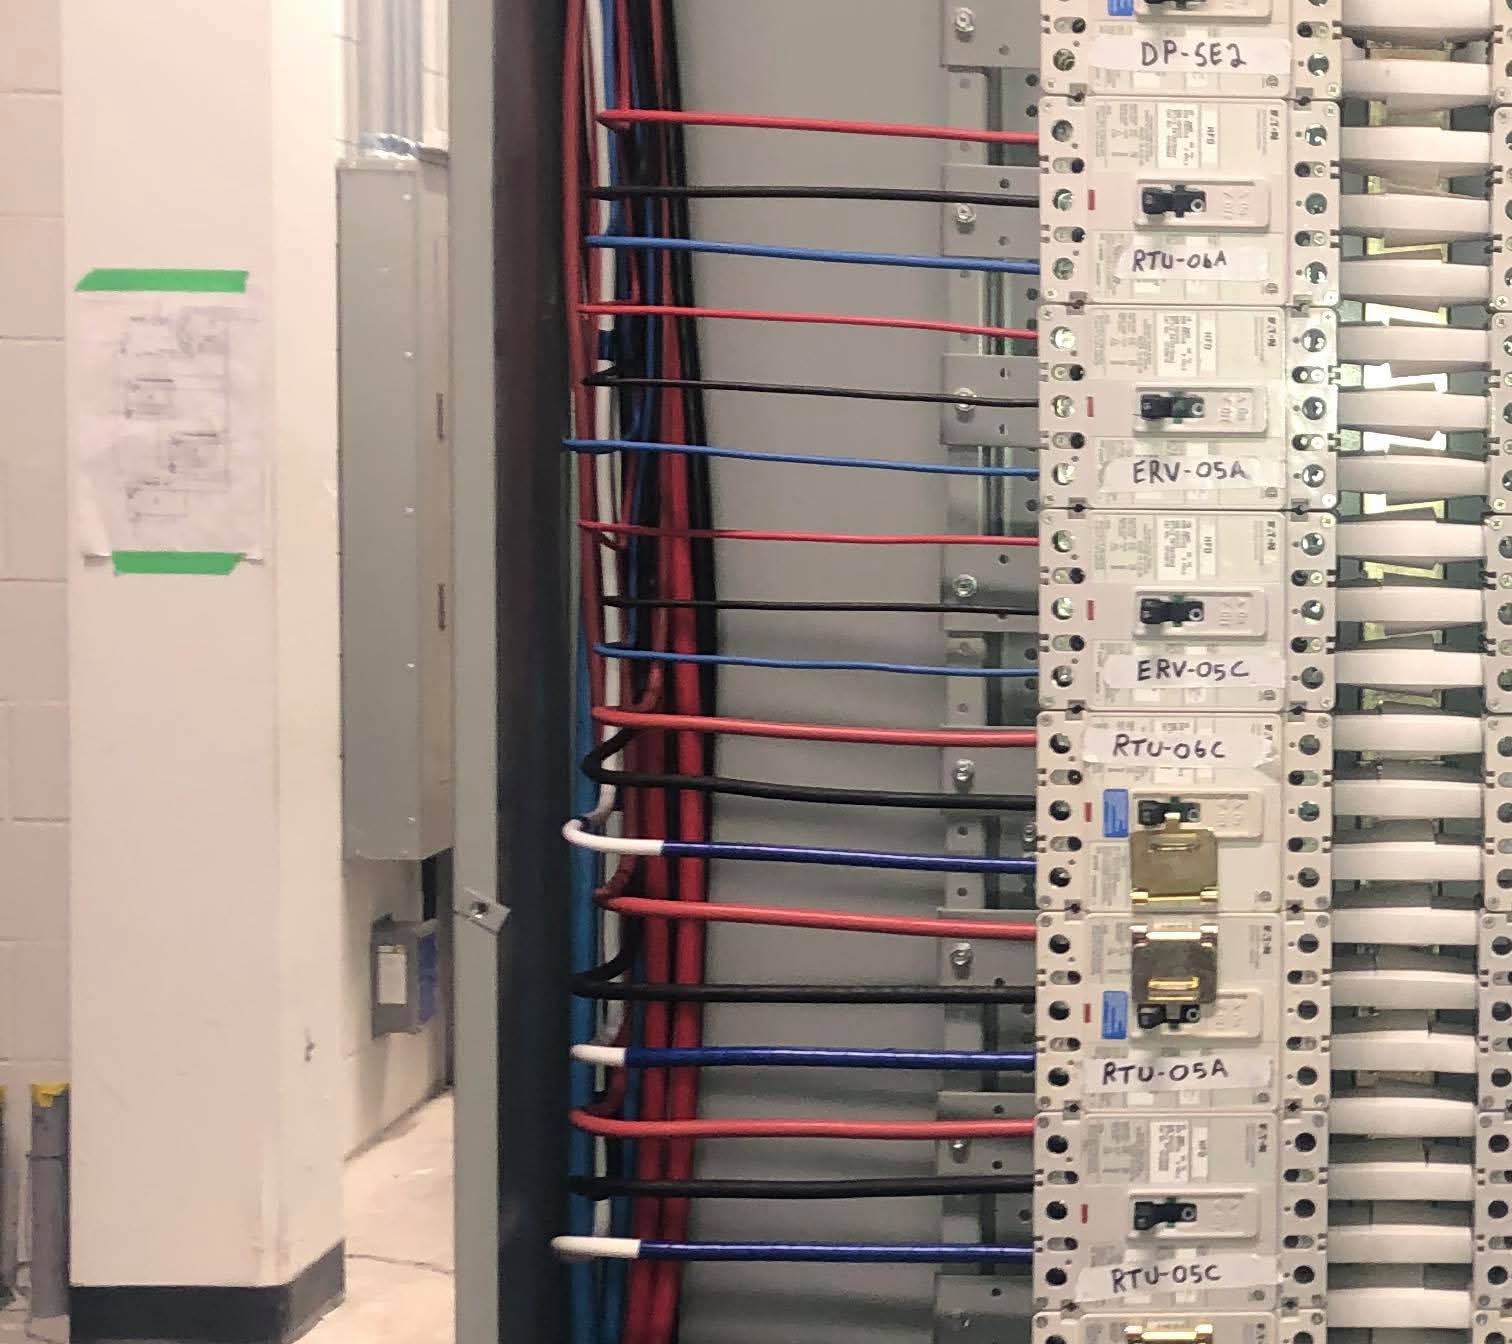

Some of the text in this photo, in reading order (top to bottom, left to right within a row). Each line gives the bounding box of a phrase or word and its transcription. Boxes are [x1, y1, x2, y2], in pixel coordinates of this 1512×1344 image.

[1140, 39, 1247, 68] DP-SE2
[1132, 249, 1228, 272] RTU-06A
[1133, 460, 1248, 484] ERV-05A
[1137, 658, 1249, 682] ERV-05C
[1112, 733, 1226, 759] RTU-06C
[1102, 1058, 1229, 1085] RTU-05A
[1111, 1264, 1222, 1293] RTU-05C
